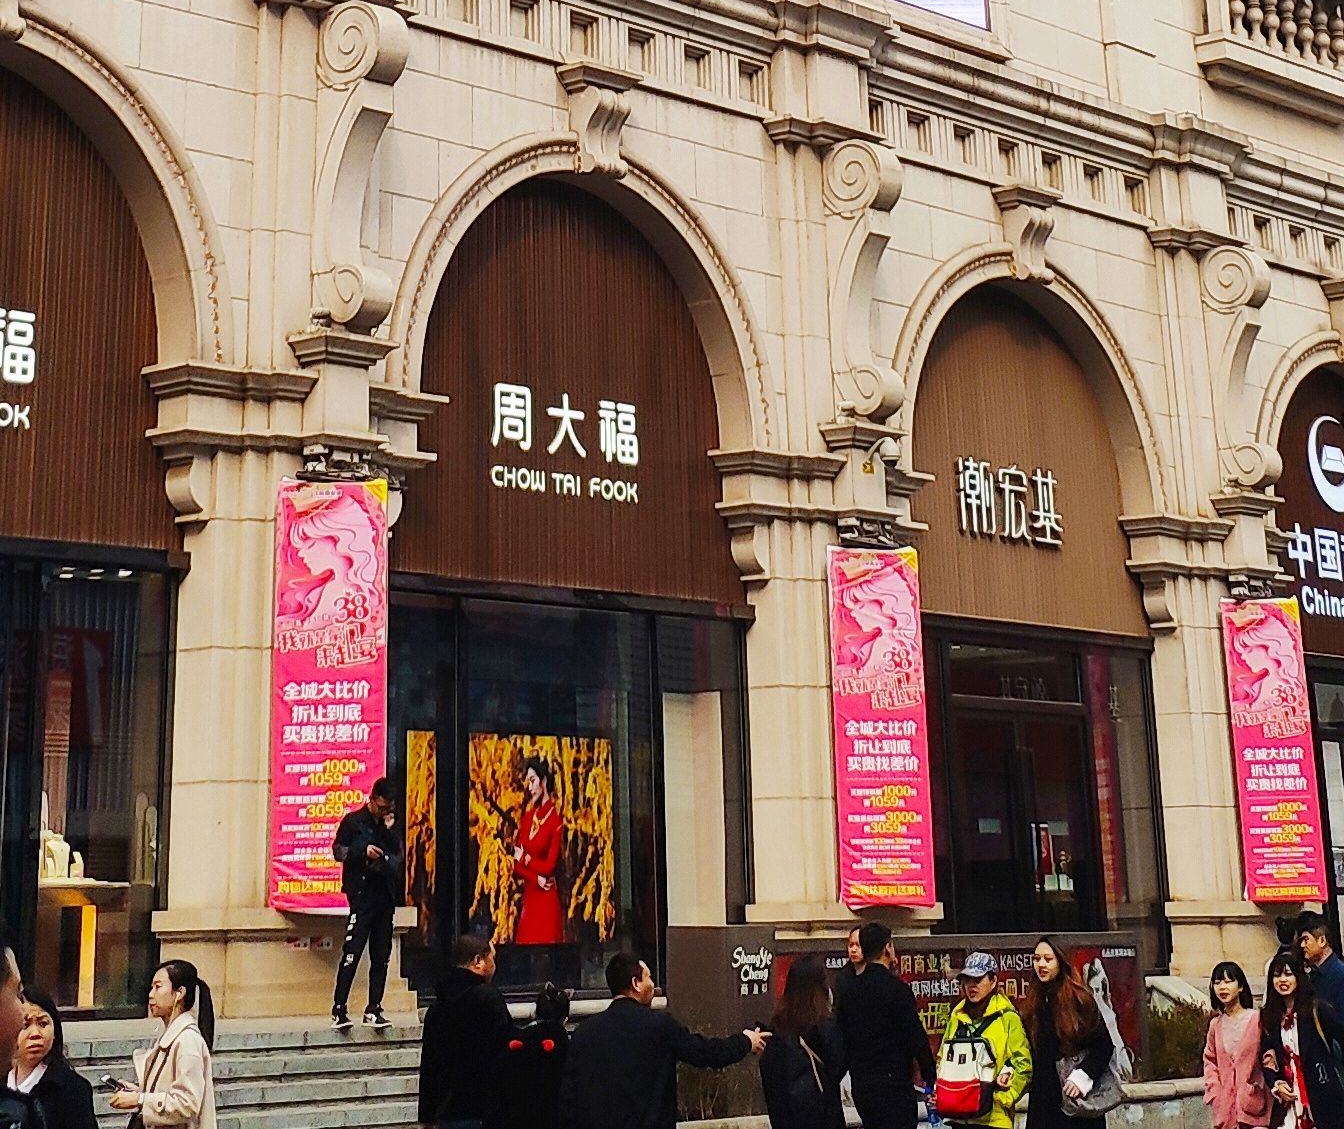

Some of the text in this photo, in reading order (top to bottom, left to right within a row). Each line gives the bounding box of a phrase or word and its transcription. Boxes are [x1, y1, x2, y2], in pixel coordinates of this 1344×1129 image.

[491, 382, 639, 467] 周大福
[490, 465, 639, 504] CHOW TAI FOOK
[958, 456, 1063, 545] 潮宏基
[333, 592, 371, 624] 38
[282, 680, 371, 701] 全城大比价
[291, 703, 362, 724] 折让到底
[282, 724, 371, 744] 买贵找差价
[844, 720, 918, 737] 全城大比价
[853, 739, 912, 755] 折让到底
[1242, 747, 1304, 761] 全城大比价
[847, 755, 921, 773] 买贵找差价
[1250, 763, 1301, 777] 折让到底
[1245, 777, 1308, 791] 买贵找差价
[741, 964, 769, 982] Cheng
[894, 953, 951, 975] 阳商业城
